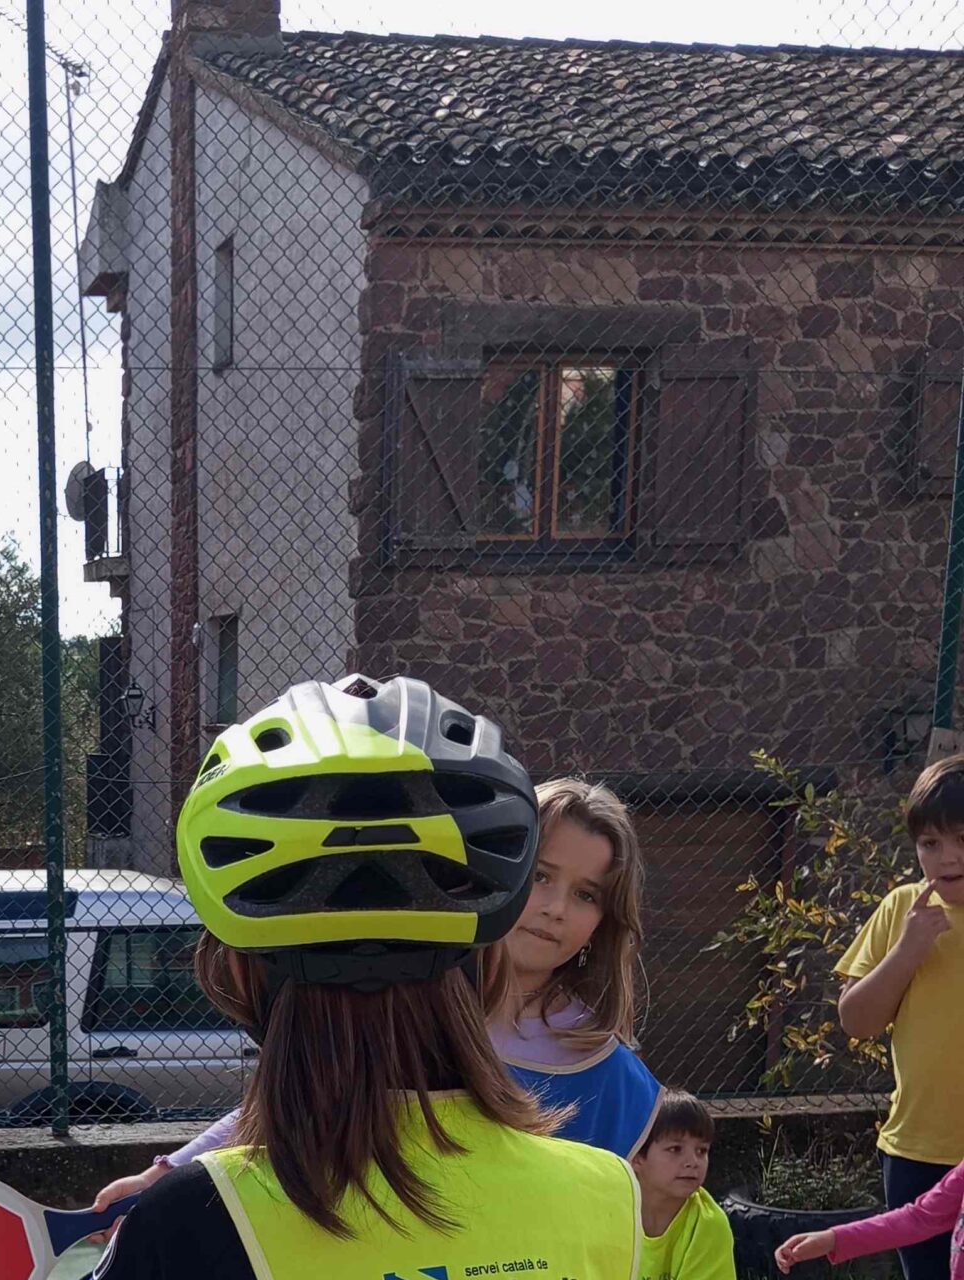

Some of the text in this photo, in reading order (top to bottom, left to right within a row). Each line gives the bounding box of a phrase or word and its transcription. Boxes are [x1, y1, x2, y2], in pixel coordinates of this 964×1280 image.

[465, 1258, 549, 1277] servei català de
